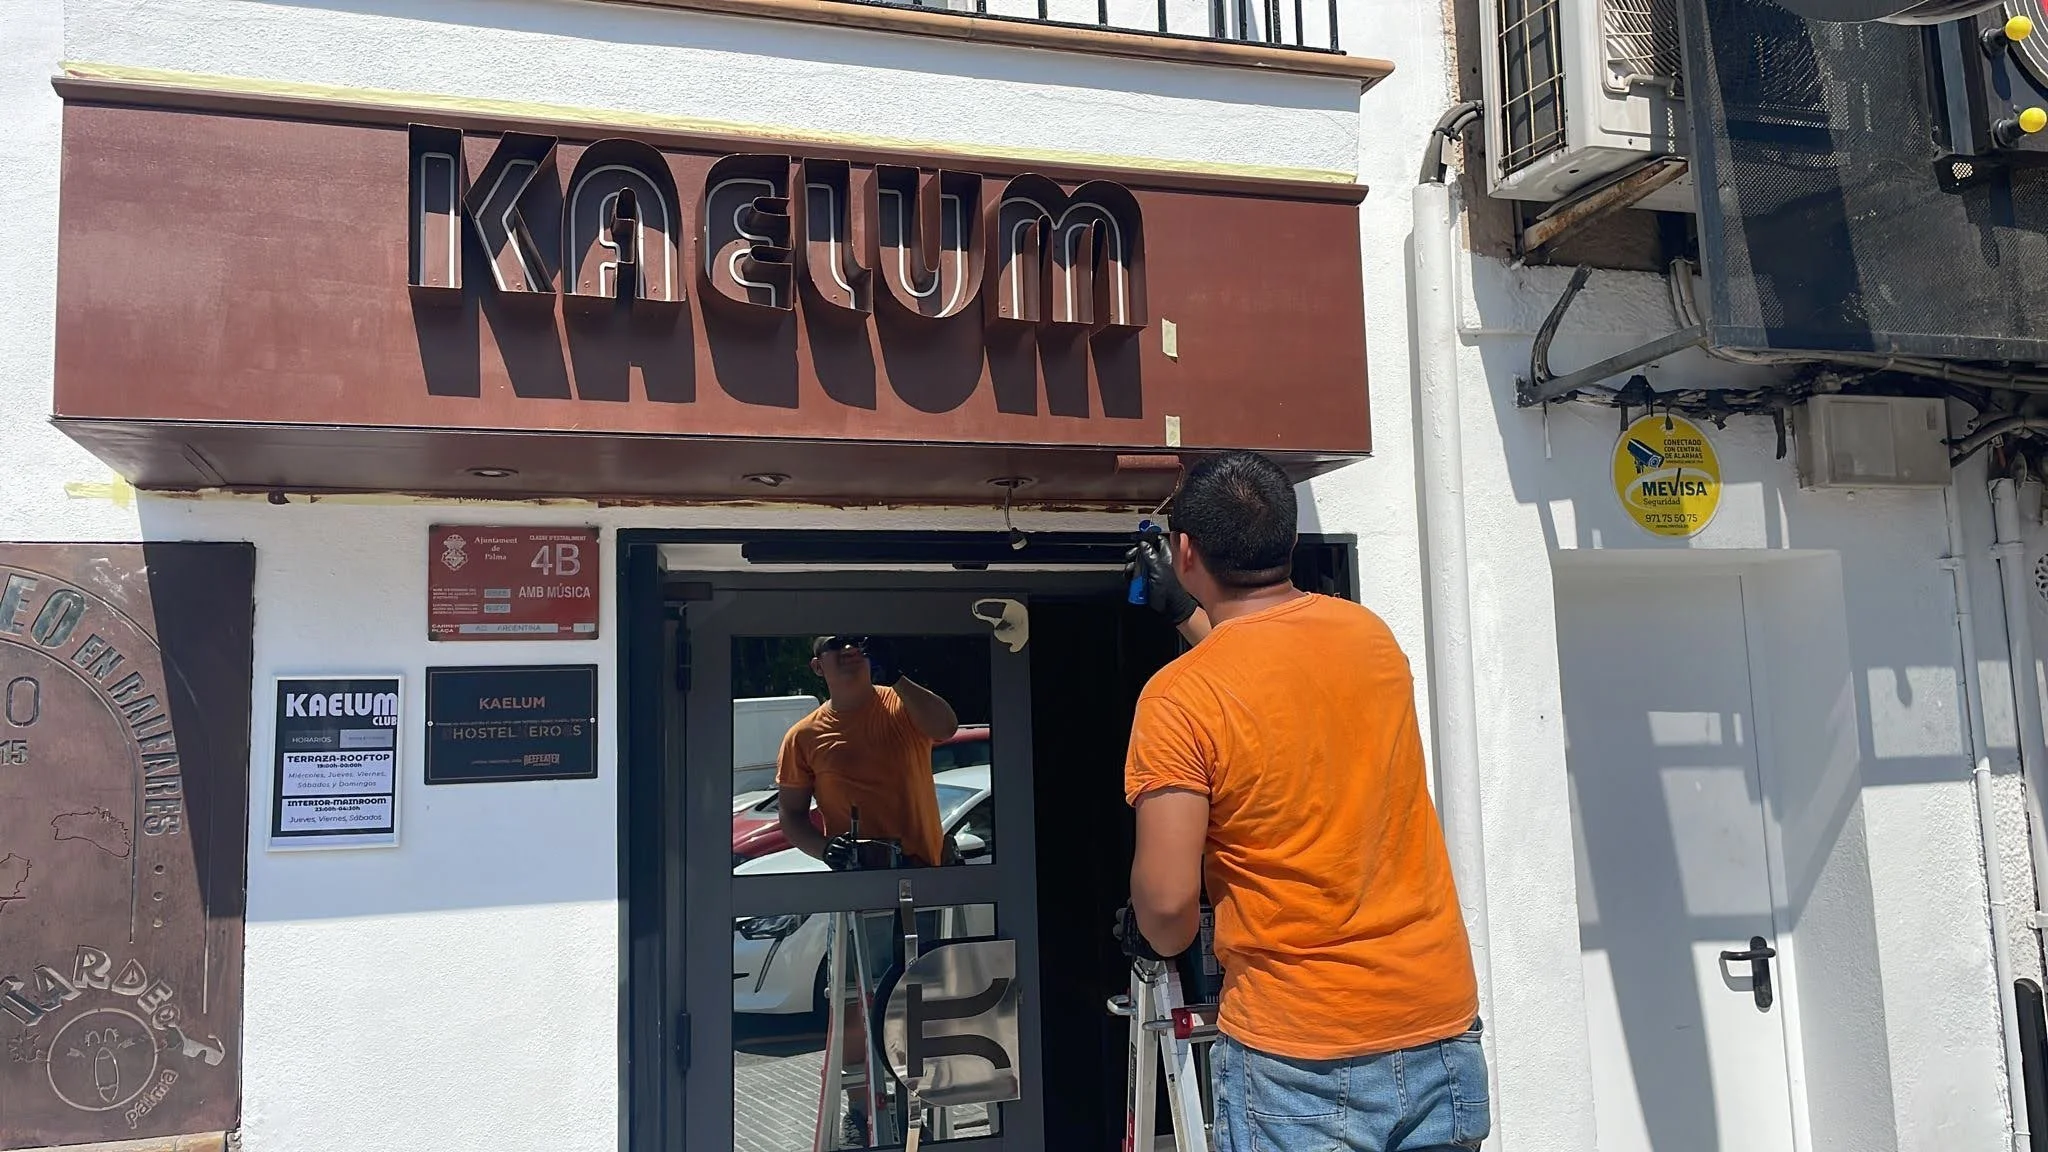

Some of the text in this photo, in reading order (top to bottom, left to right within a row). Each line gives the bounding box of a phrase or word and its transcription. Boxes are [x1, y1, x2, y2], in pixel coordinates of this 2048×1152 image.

[408, 123, 1148, 334] KAELUM
[1642, 468, 1707, 496] MEVISA
[1643, 498, 1681, 507] Seguridad
[1645, 513, 1660, 523] 971
[1661, 513, 1673, 523] 75
[1687, 513, 1698, 523] 75
[474, 536, 518, 545] Ajuntament
[485, 553, 507, 561] Palma
[530, 543, 581, 576] 4B
[518, 586, 544, 599] AMB
[547, 583, 591, 599] MÚSICA
[285, 692, 398, 717] KAELUM
[479, 696, 546, 710] KAELUM
[372, 716, 398, 726] CLUB
[70, 633, 126, 683] EN
[107, 671, 184, 836] BALEARES
[453, 727, 517, 740] HOSTEL
[287, 753, 391, 763] TERRAZA-ROOFTOP
[297, 780, 331, 788] Sábados
[338, 779, 378, 788] Domingos
[287, 797, 387, 806] INTERIOR-MAINROOM
[349, 813, 383, 822] Sábados
